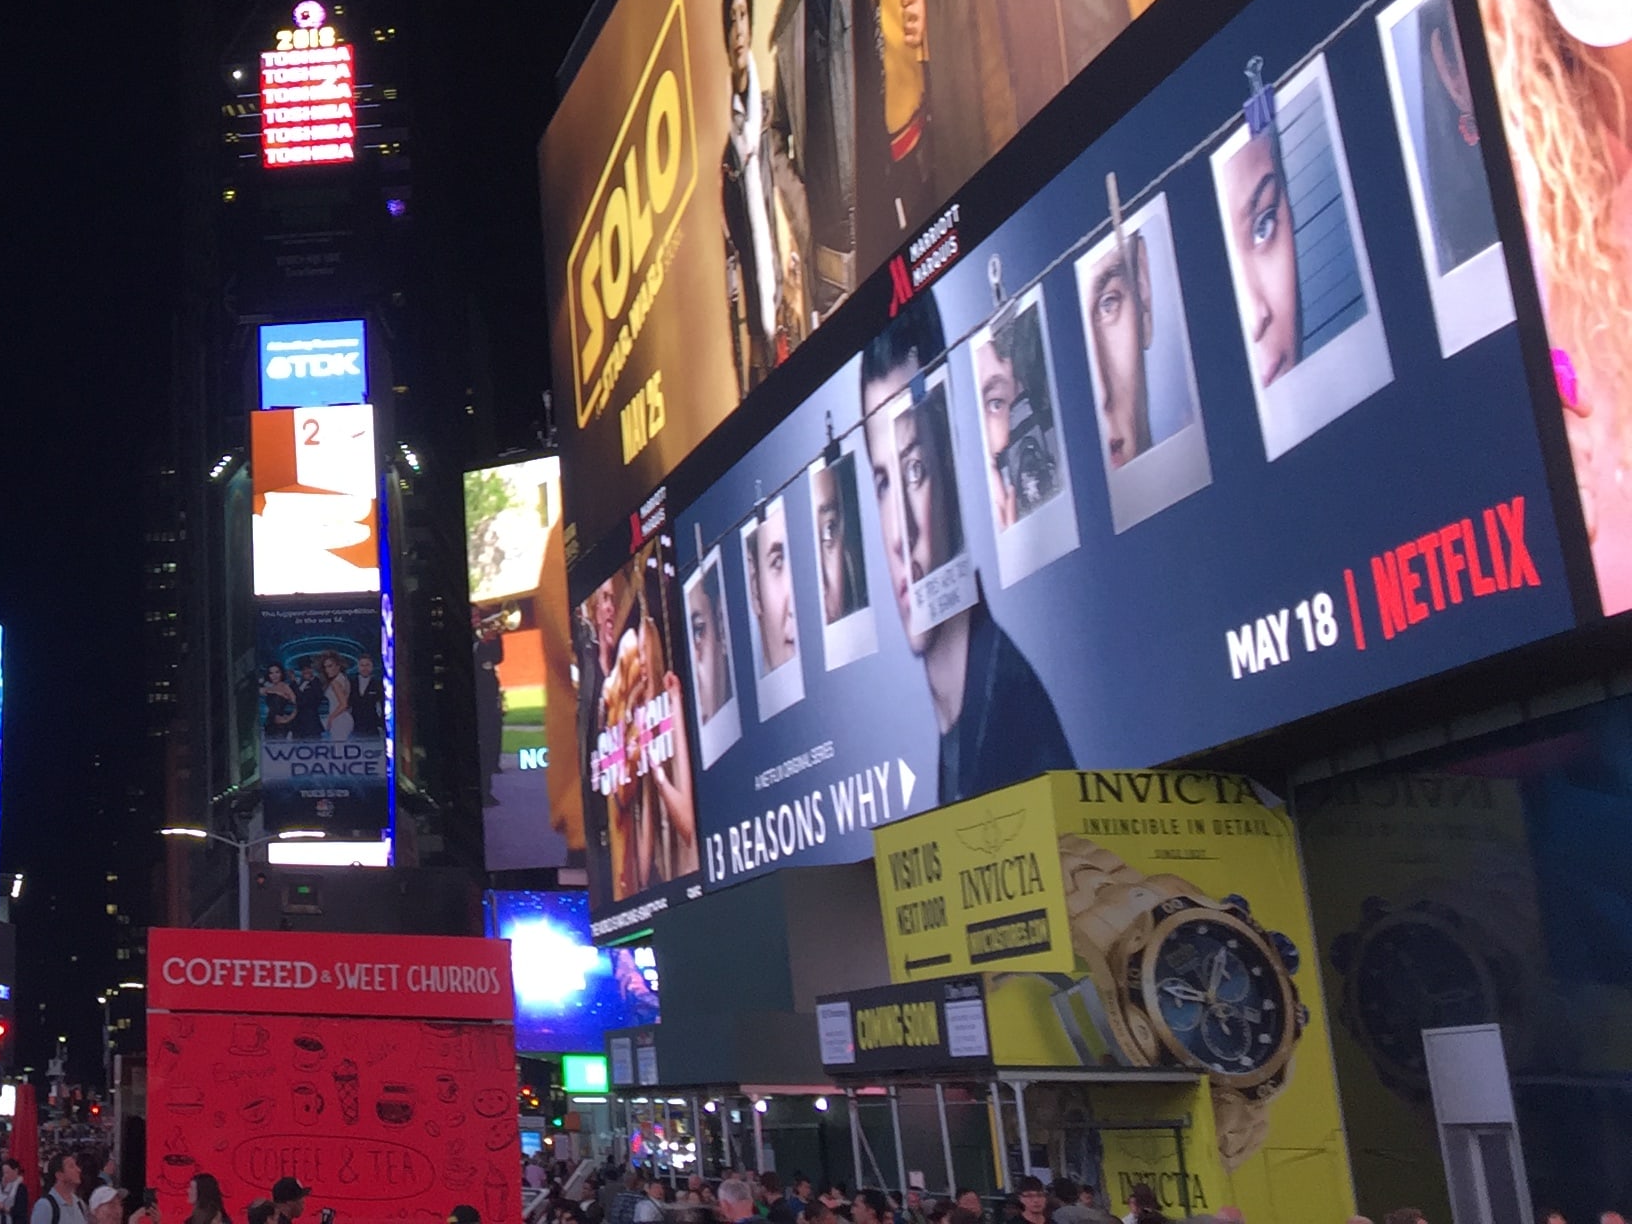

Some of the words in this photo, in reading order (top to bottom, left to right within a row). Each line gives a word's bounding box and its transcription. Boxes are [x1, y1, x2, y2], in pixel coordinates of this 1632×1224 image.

[275, 26, 336, 51] 2018
[261, 46, 351, 67] TOSHIBA
[261, 63, 352, 85] TOSHIBA
[262, 102, 354, 124] TOSHIBA
[264, 123, 354, 144] TOSHIBA
[264, 142, 355, 164] TOSHIBA
[580, 69, 683, 385] SOLO
[909, 204, 960, 263] MARRIOTT
[912, 235, 959, 287] MARQUIS
[287, 352, 361, 379] TDK
[302, 418, 321, 446] 2
[620, 387, 649, 466] MAY
[645, 369, 666, 439] 25
[1225, 608, 1292, 680] MAY
[1294, 591, 1339, 653] 18
[1370, 495, 1542, 641] NETFLIX
[264, 744, 362, 761] WORLD
[291, 761, 379, 777] DANCE
[1075, 771, 1265, 806] INVICTA
[706, 833, 726, 883] 13
[728, 790, 827, 875] REASONS
[828, 760, 891, 836] WHY
[1082, 818, 1181, 835] INVINCIBLE
[1186, 818, 1206, 835] IN
[958, 852, 1045, 910] INVICTA
[162, 956, 318, 989] COFFEED
[320, 970, 332, 984] &
[335, 962, 401, 993] SWEET
[406, 964, 501, 995] CHURROS
[855, 1003, 904, 1052] COMING
[901, 1000, 941, 1048] SOON
[248, 1146, 323, 1185] COFFEE
[338, 1144, 360, 1185] &
[368, 1148, 418, 1186] TEA
